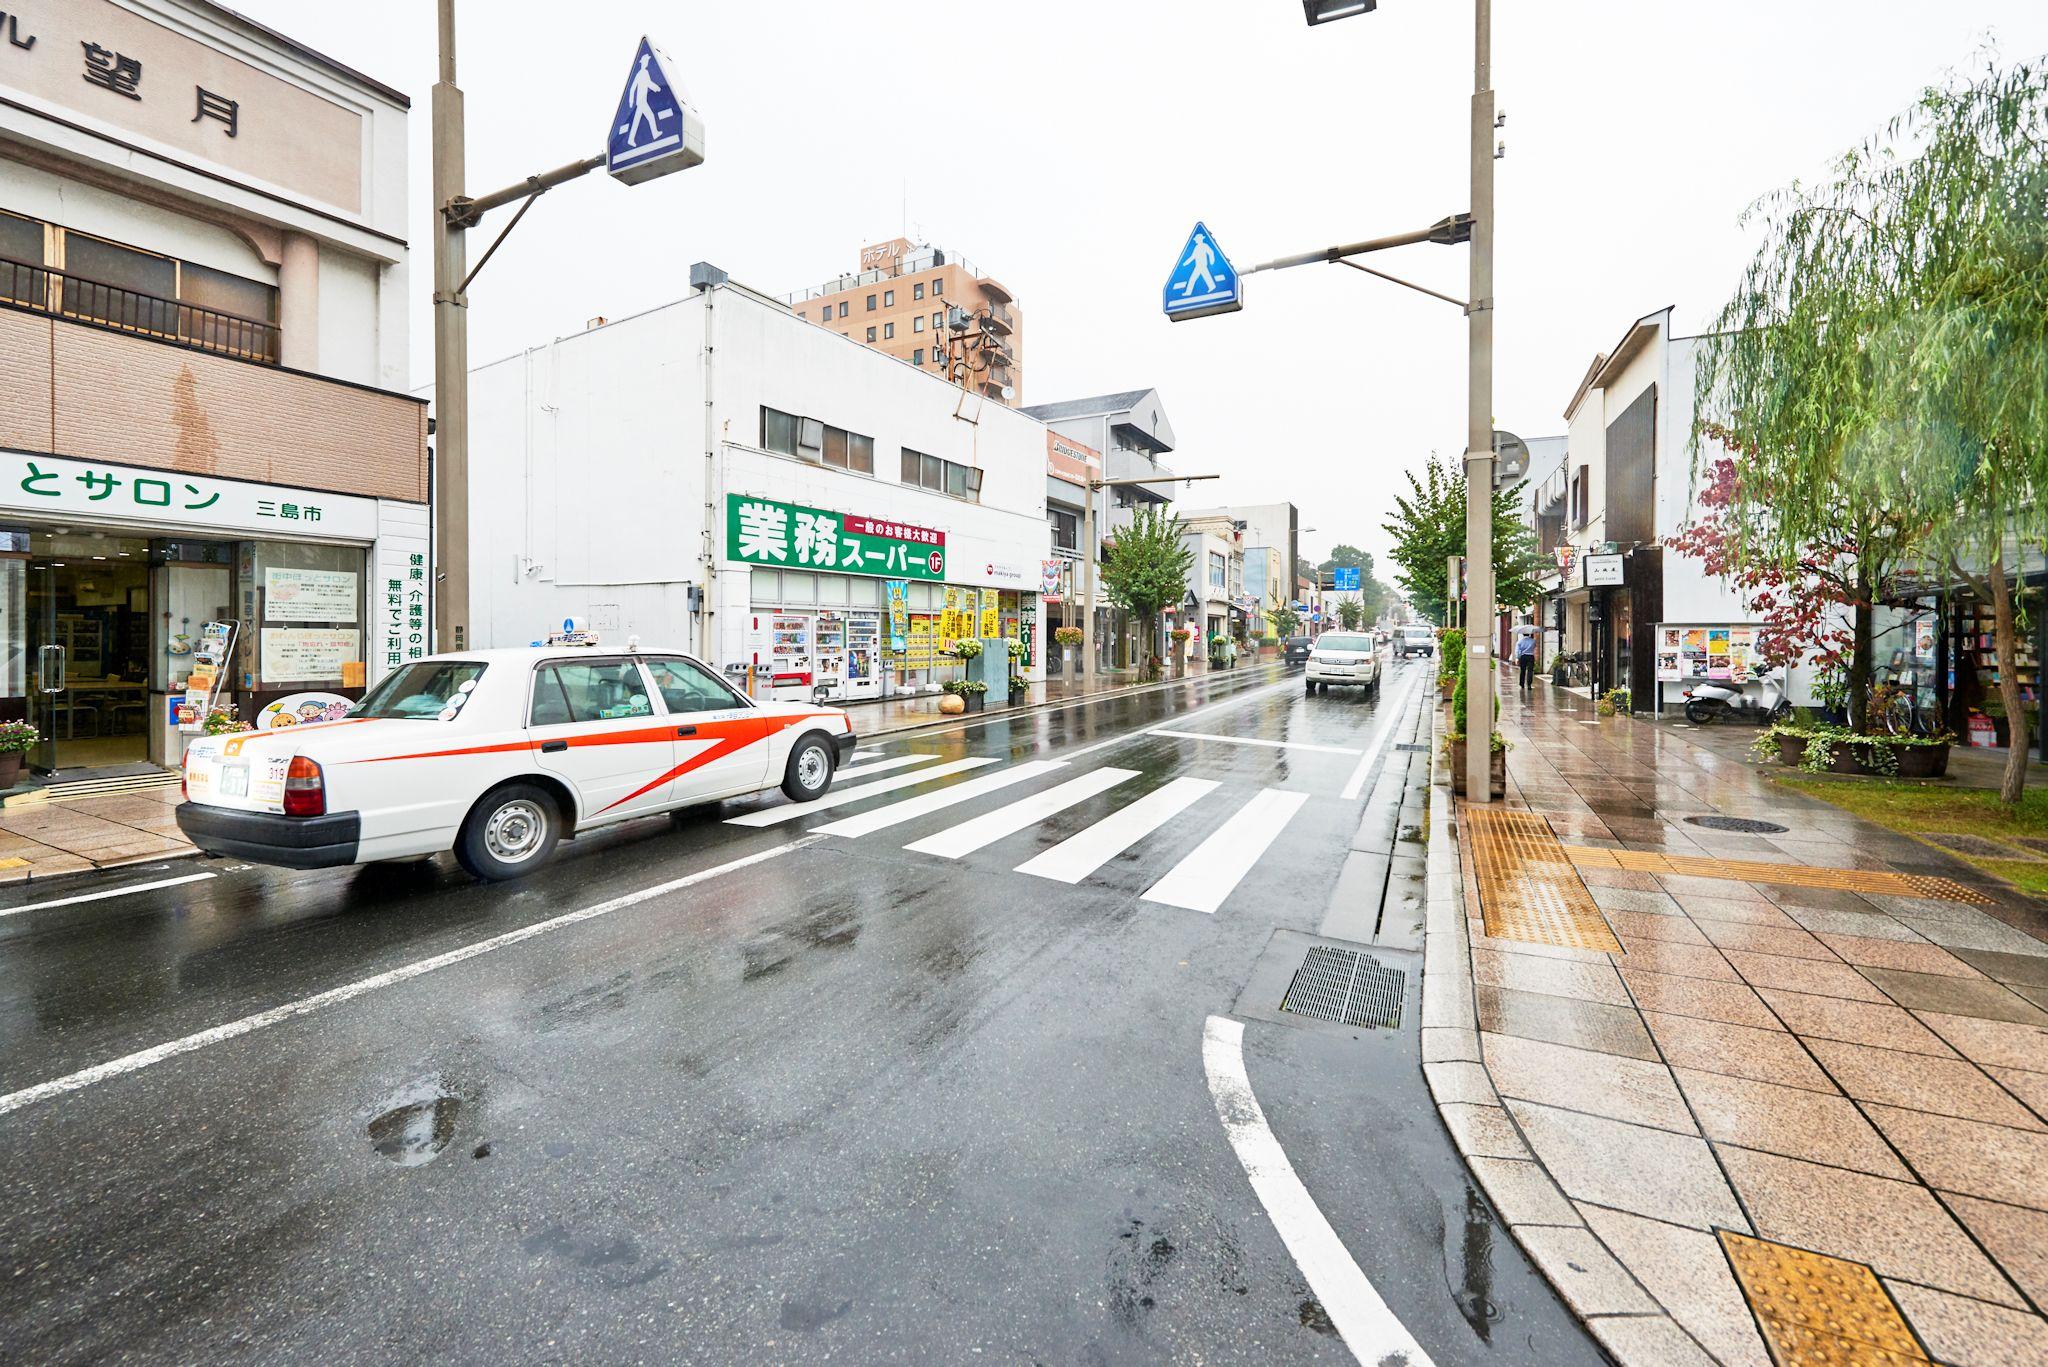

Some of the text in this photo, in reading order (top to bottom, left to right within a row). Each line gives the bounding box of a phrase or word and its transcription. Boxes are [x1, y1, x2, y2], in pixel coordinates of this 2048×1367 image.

[863, 242, 900, 264] ホテル
[1053, 441, 1088, 463] BRIDGESTONE
[20, 461, 221, 511] とサロン
[255, 499, 323, 523] 三島市
[738, 501, 926, 572] 業務スーパー
[854, 521, 938, 545] 一般のお客様大歓迎
[930, 555, 942, 570] 1F
[387, 579, 402, 670] 無料でご利用
[1021, 595, 1036, 661] 業務スーパー
[455, 625, 464, 652] 静岡県
[268, 767, 285, 781] 319
